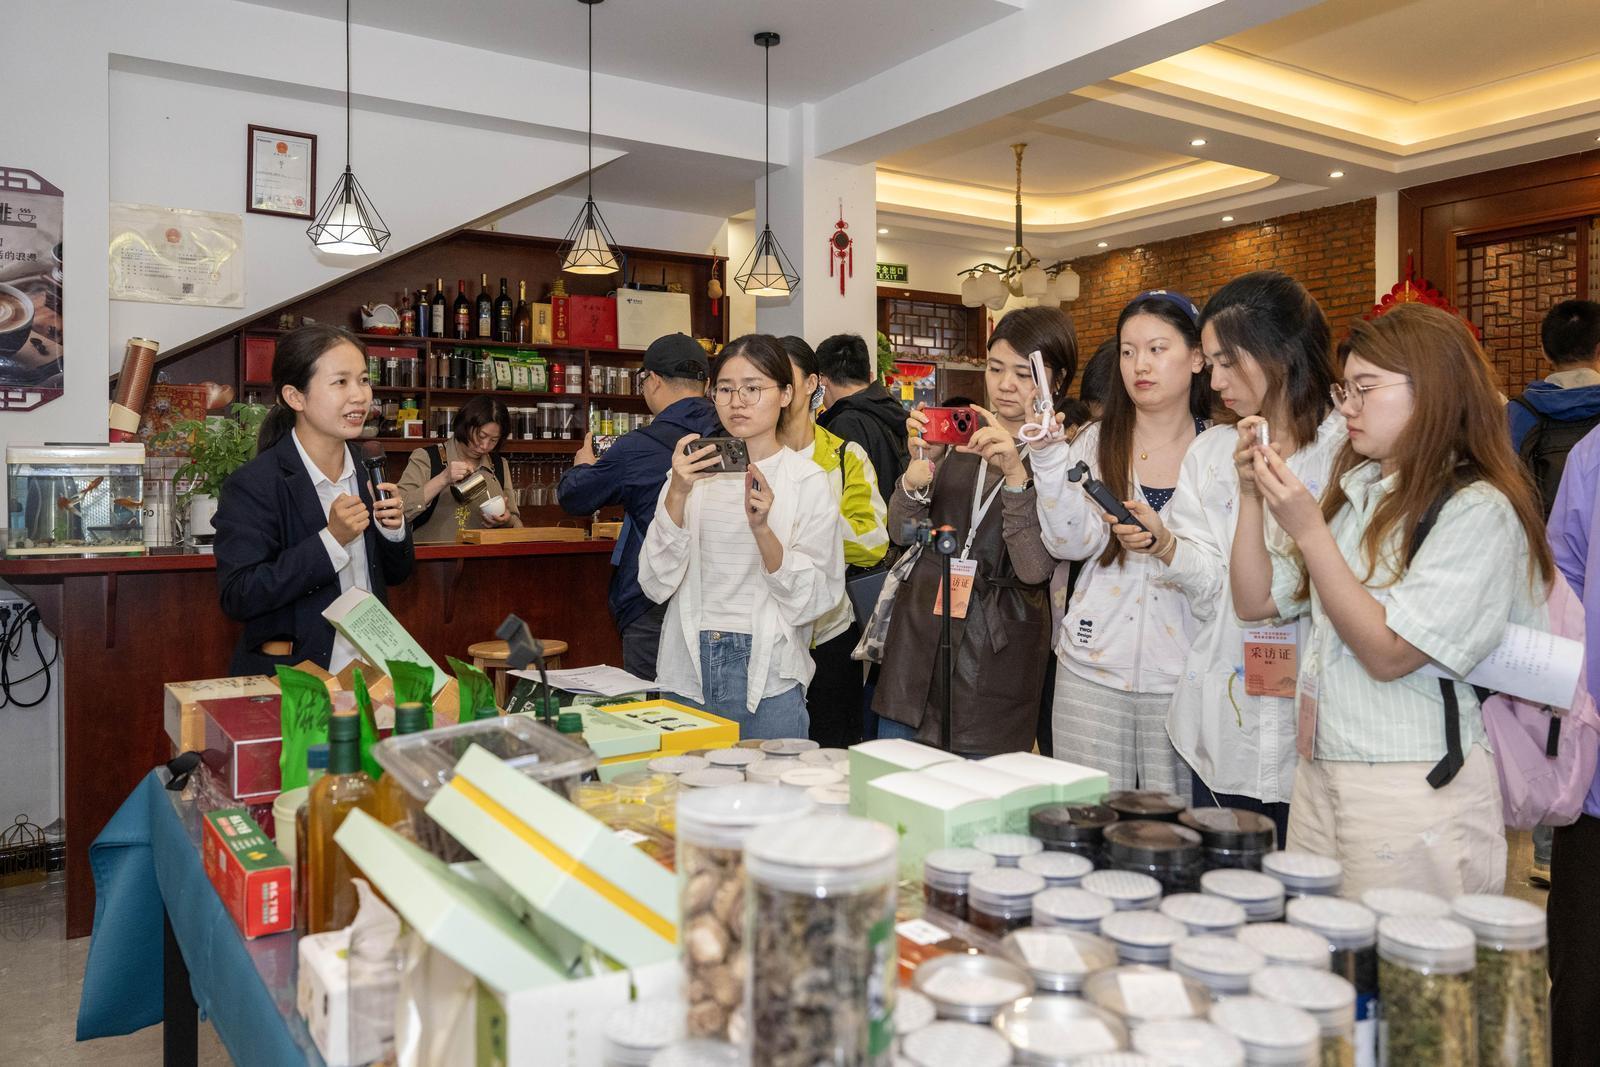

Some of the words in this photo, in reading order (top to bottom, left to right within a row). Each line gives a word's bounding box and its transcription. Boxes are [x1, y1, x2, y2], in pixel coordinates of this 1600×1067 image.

[952, 577, 971, 589] 访证
[1251, 646, 1292, 660] 采访证
